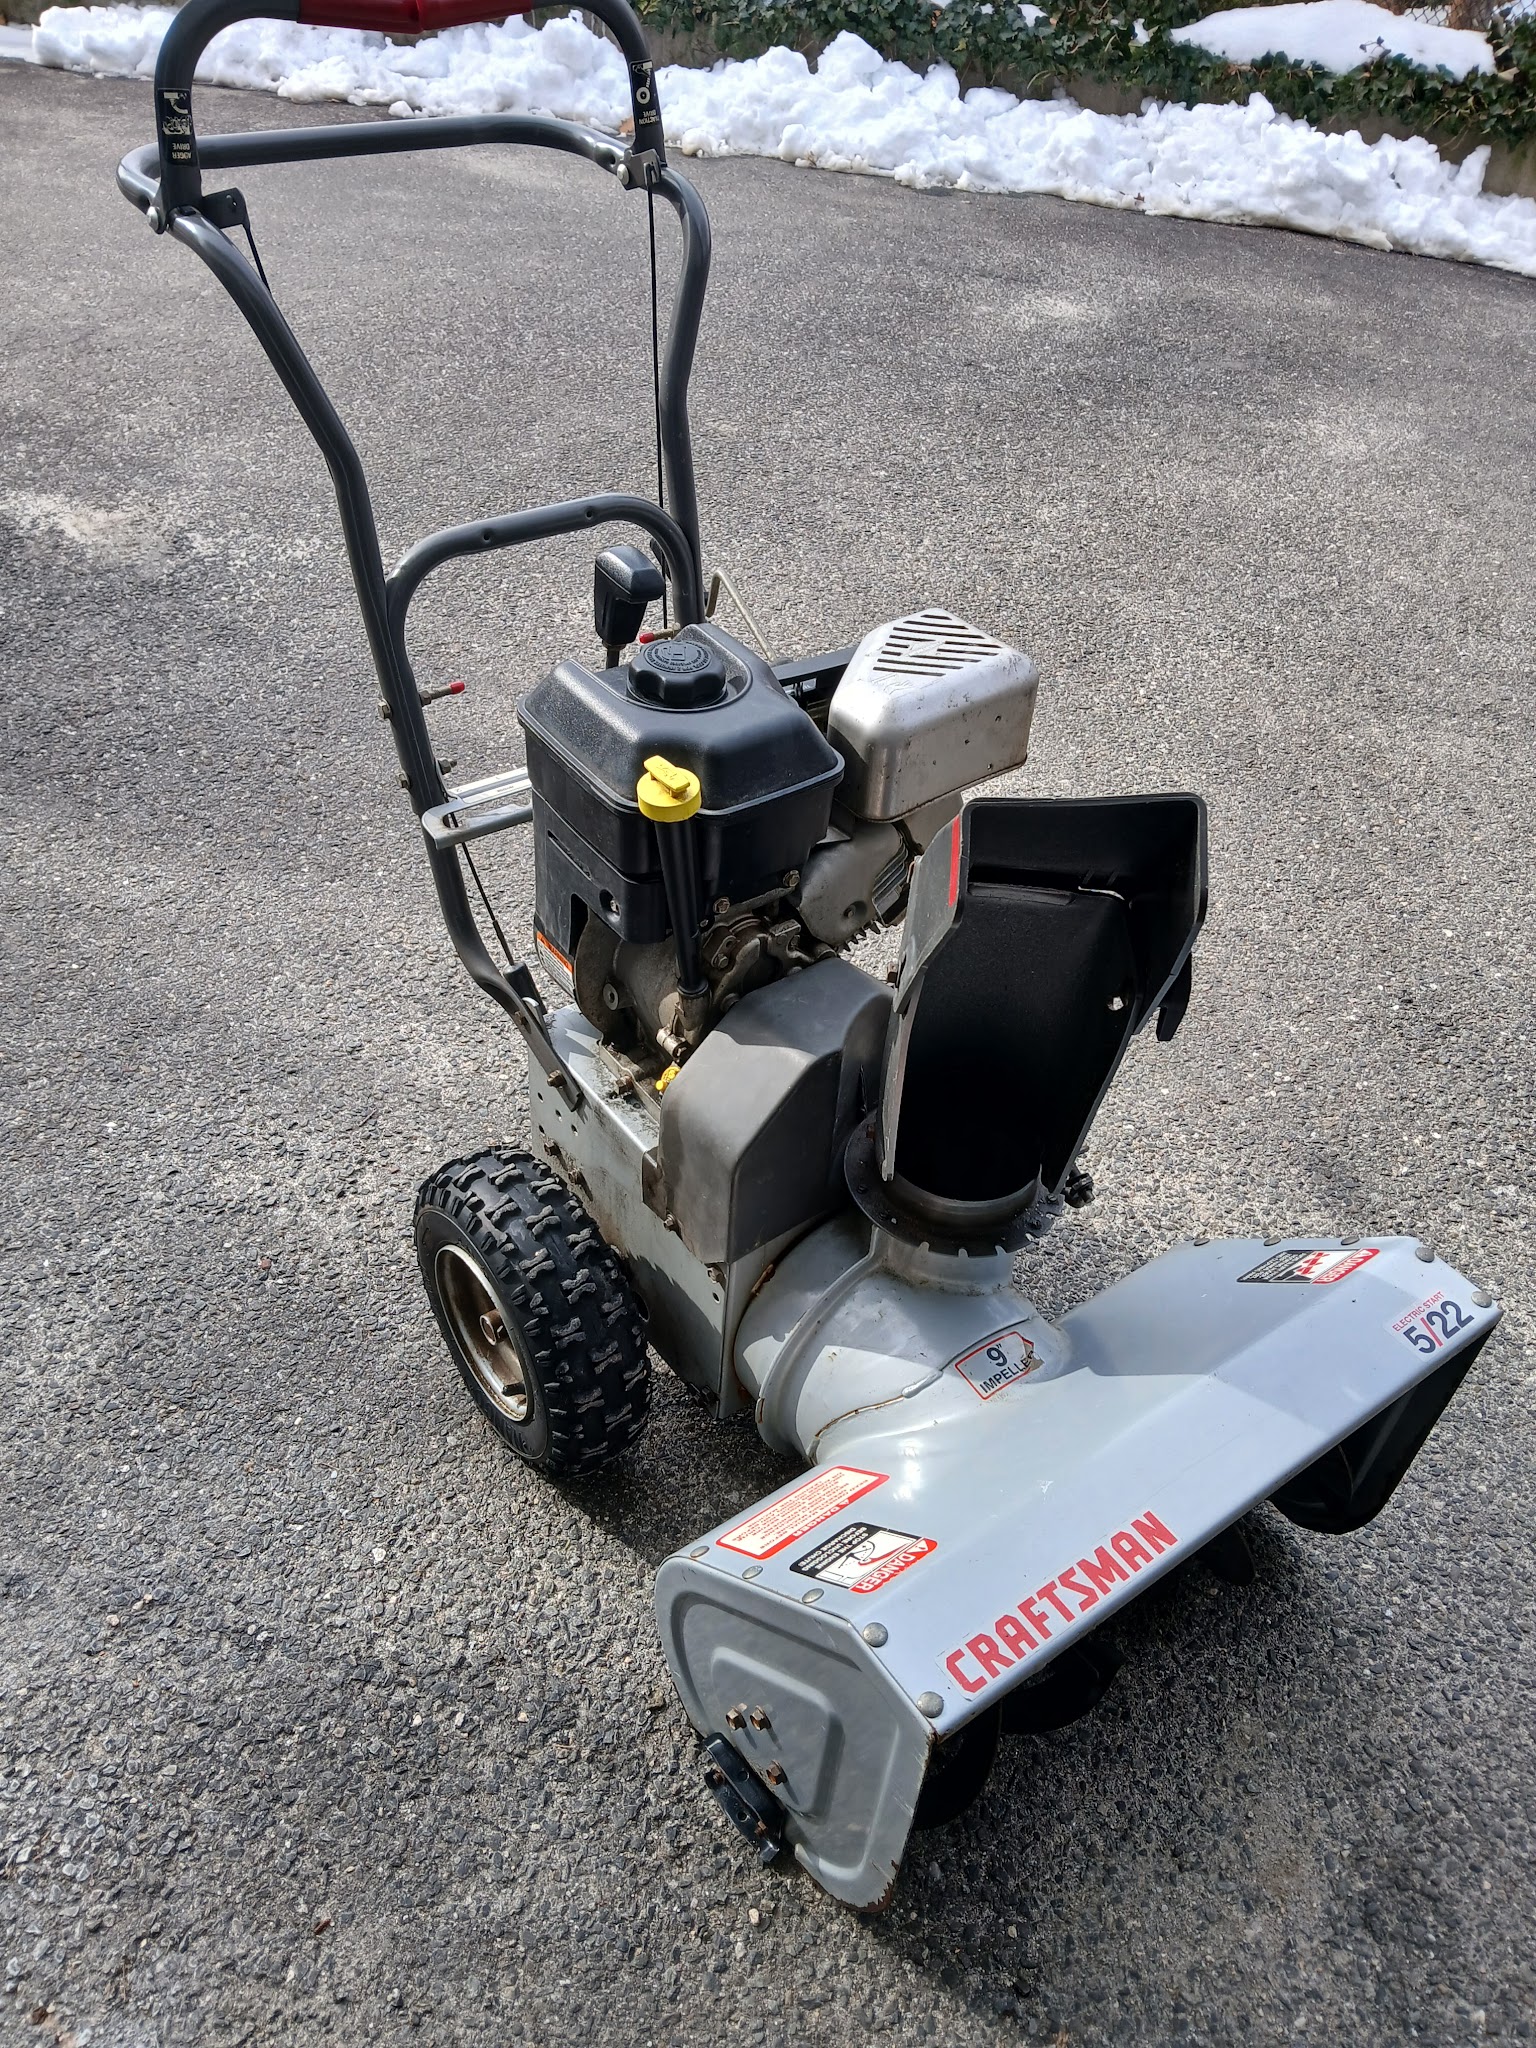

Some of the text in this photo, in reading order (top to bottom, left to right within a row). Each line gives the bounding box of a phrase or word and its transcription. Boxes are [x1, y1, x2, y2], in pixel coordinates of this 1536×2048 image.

[172, 142, 190, 150] DRIVE
[1317, 1257, 1367, 1283] DANGER
[1392, 1291, 1445, 1332] ELECTRIC START
[1403, 1300, 1474, 1354] 5/22
[986, 1343, 1008, 1367] 9"
[790, 1506, 840, 1536] DANGER
[819, 1526, 857, 1551] DISCHARGE
[800, 1526, 868, 1571] BEFORE UNCLOGGING
[813, 1532, 869, 1569] STOP THE ENGINE
[854, 1552, 916, 1591] DANGER
[946, 1511, 1178, 1693] CRAFTSMAN
